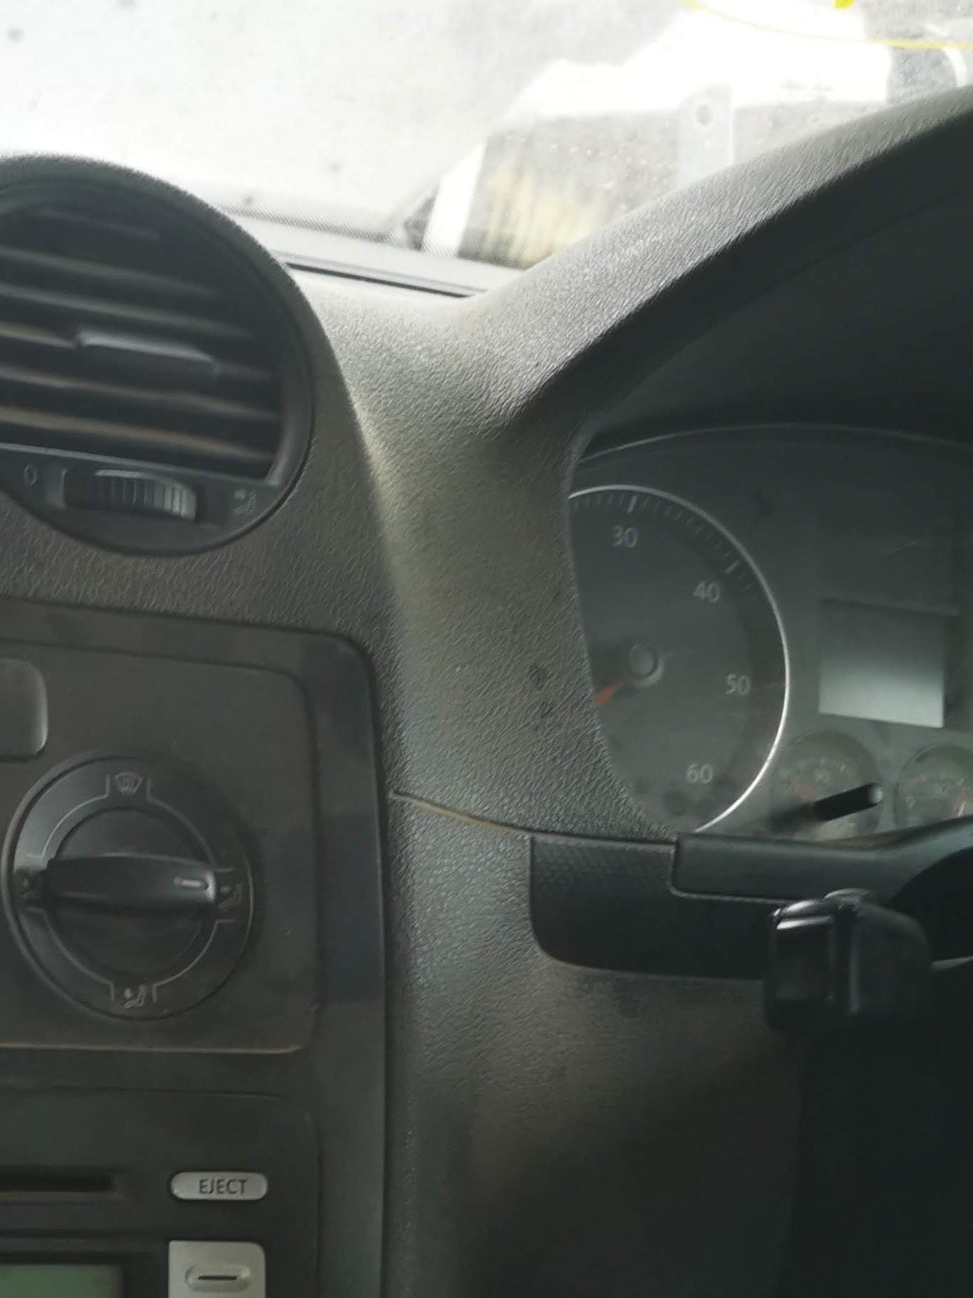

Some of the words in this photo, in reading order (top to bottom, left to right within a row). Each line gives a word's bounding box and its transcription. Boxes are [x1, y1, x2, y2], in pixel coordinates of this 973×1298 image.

[611, 525, 638, 548] 30
[693, 581, 720, 603] 40
[727, 674, 750, 696] 50
[685, 763, 714, 784] 60
[199, 1178, 247, 1196] EJECT
